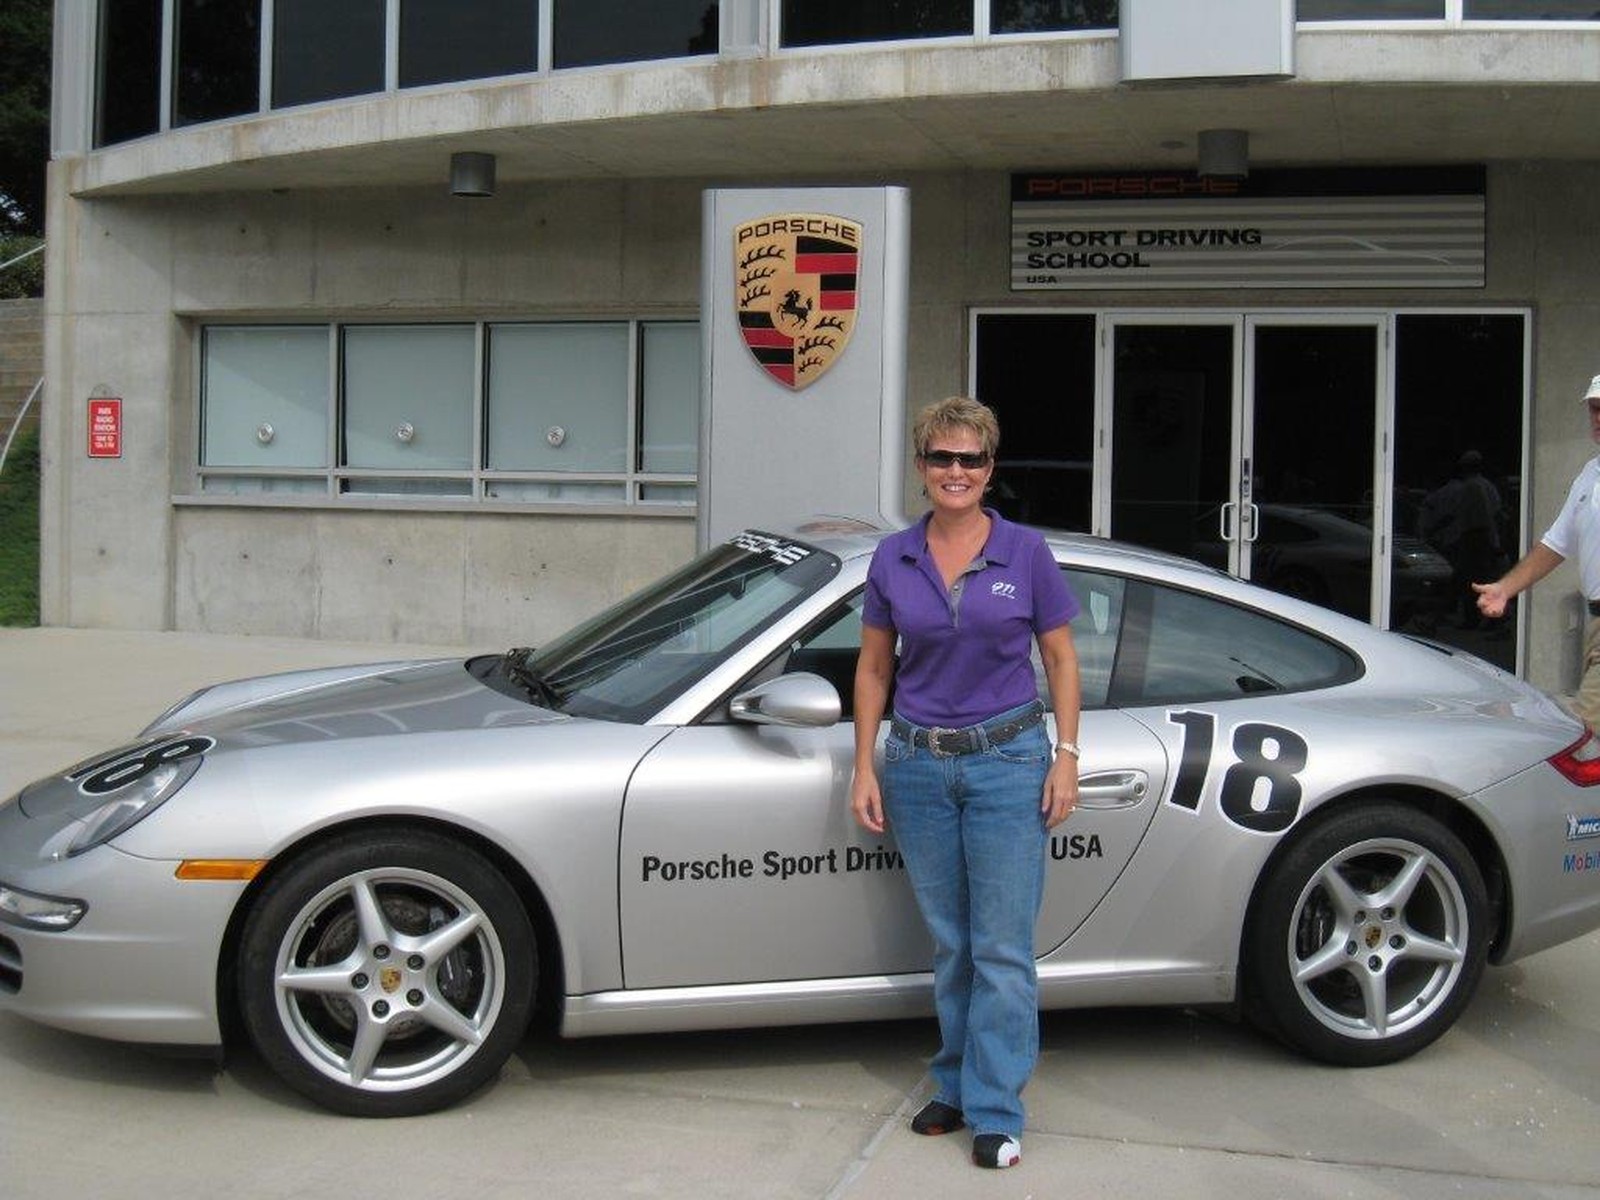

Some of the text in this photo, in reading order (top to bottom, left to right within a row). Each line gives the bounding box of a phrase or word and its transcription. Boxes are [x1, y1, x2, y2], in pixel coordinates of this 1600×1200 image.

[738, 219, 856, 243] PORSCHE
[1027, 227, 1262, 248] SPORT DRIVING
[1027, 251, 1150, 270] SCHOOL
[1026, 275, 1057, 284] USA
[65, 731, 216, 796] 18
[1168, 709, 1309, 834] 18
[642, 853, 754, 882] Porsche
[763, 848, 837, 880] Sport
[1051, 834, 1103, 860] USA
